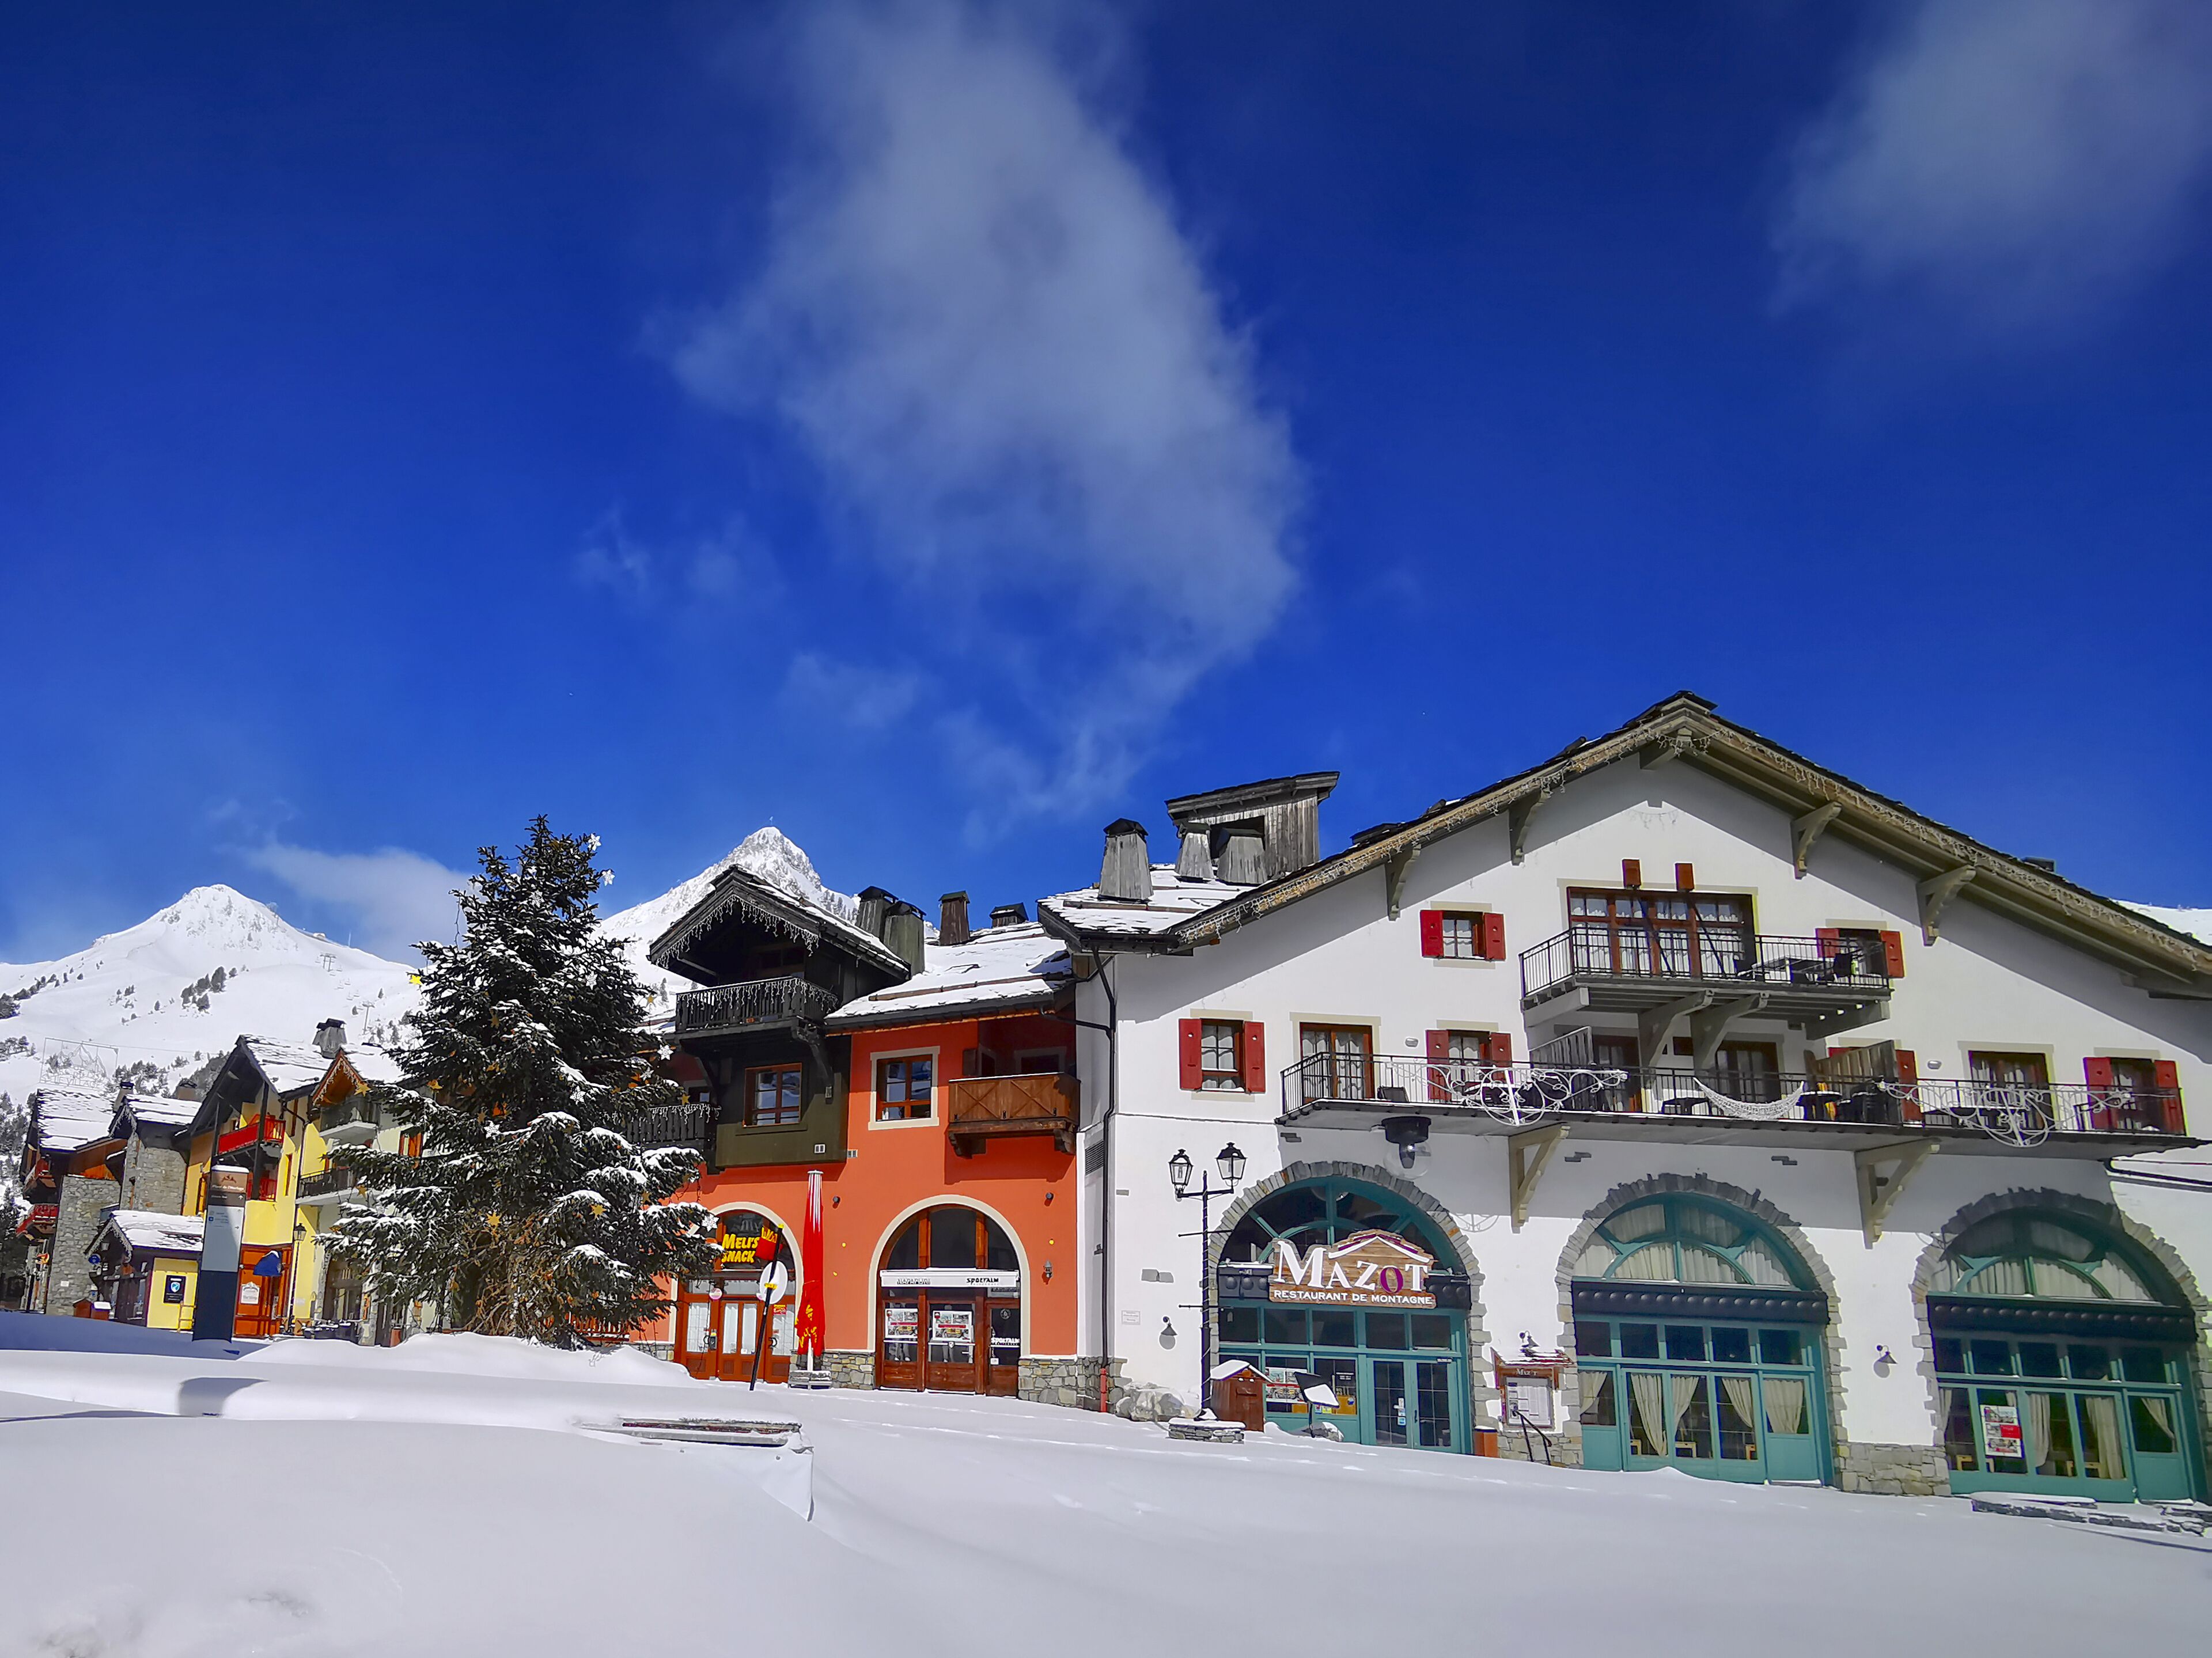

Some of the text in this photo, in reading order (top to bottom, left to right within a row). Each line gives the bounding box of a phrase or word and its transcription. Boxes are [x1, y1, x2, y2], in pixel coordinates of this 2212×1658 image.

[722, 1234, 760, 1249] MELI'S
[721, 1250, 756, 1263] SNACK
[1273, 1240, 1429, 1294] MAZOT
[1274, 1290, 1433, 1305] RESTAURANT DE MONTAGNE
